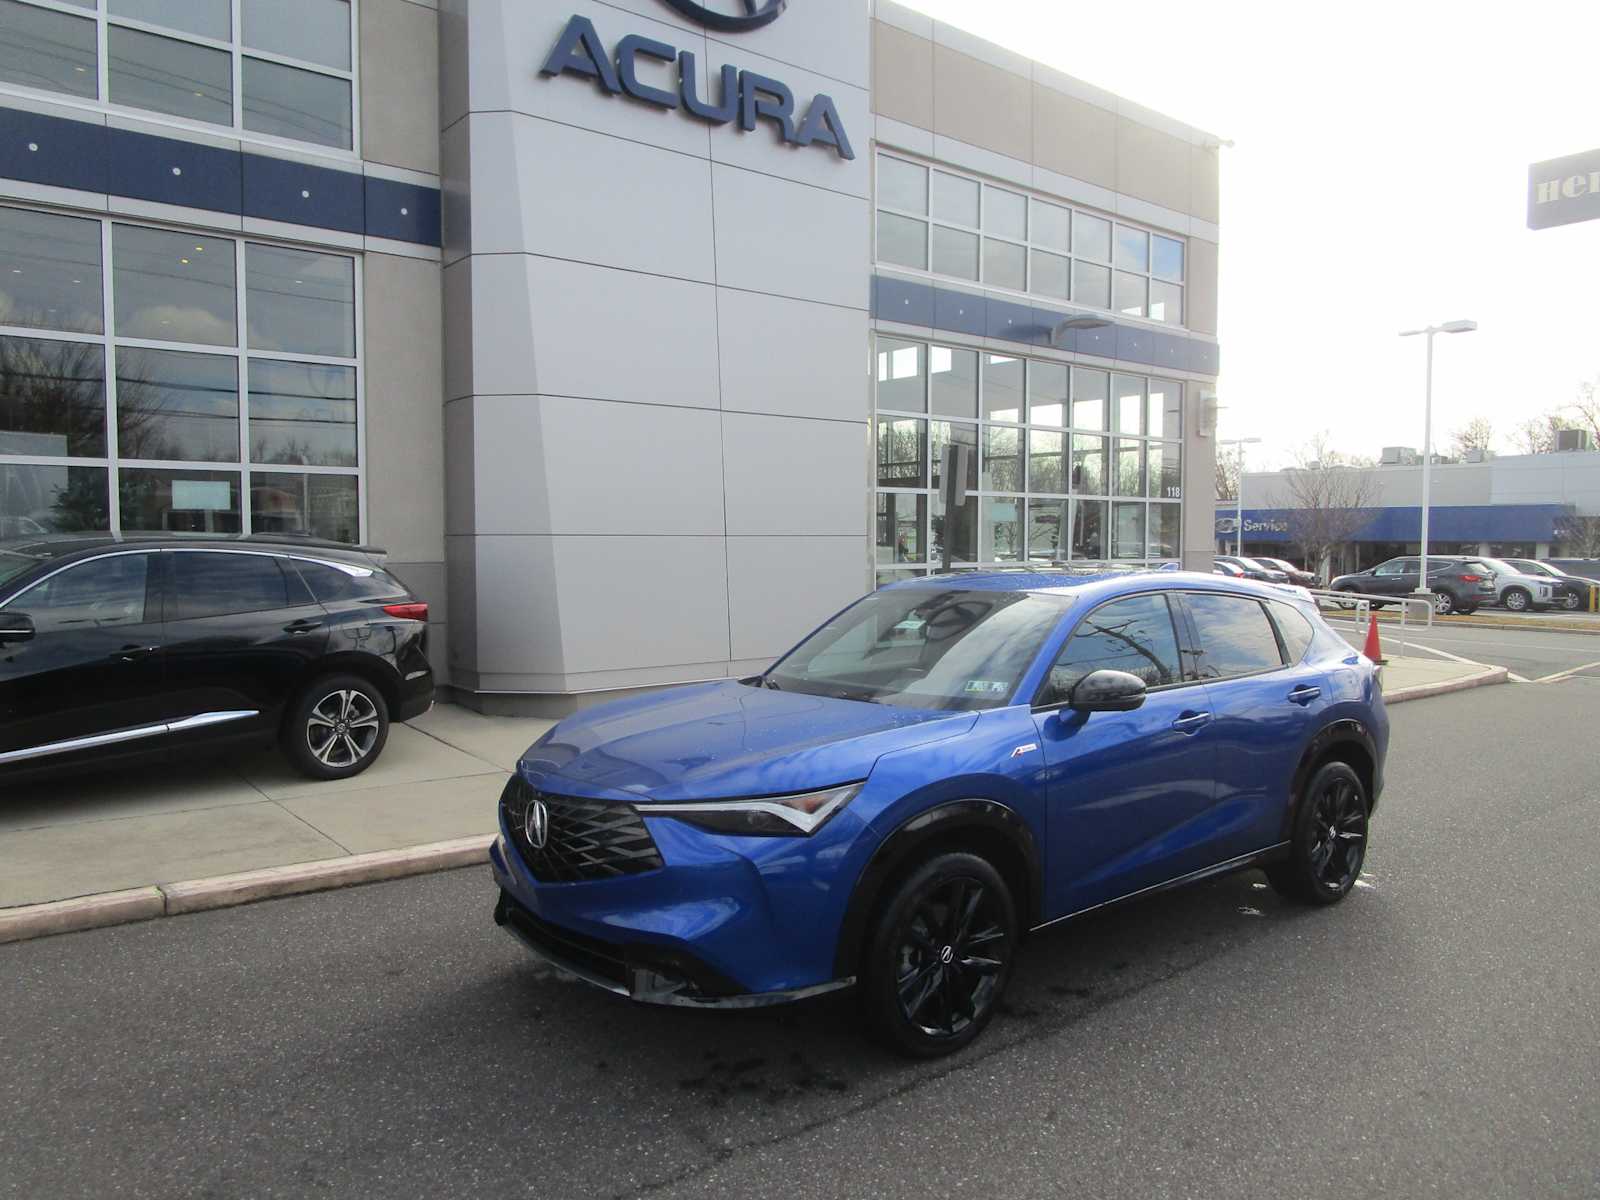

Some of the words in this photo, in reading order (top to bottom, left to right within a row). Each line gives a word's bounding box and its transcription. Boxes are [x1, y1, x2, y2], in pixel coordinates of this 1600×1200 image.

[538, 14, 855, 160] ACURA
[1167, 486, 1181, 498] 118
[1243, 519, 1288, 532] Service
